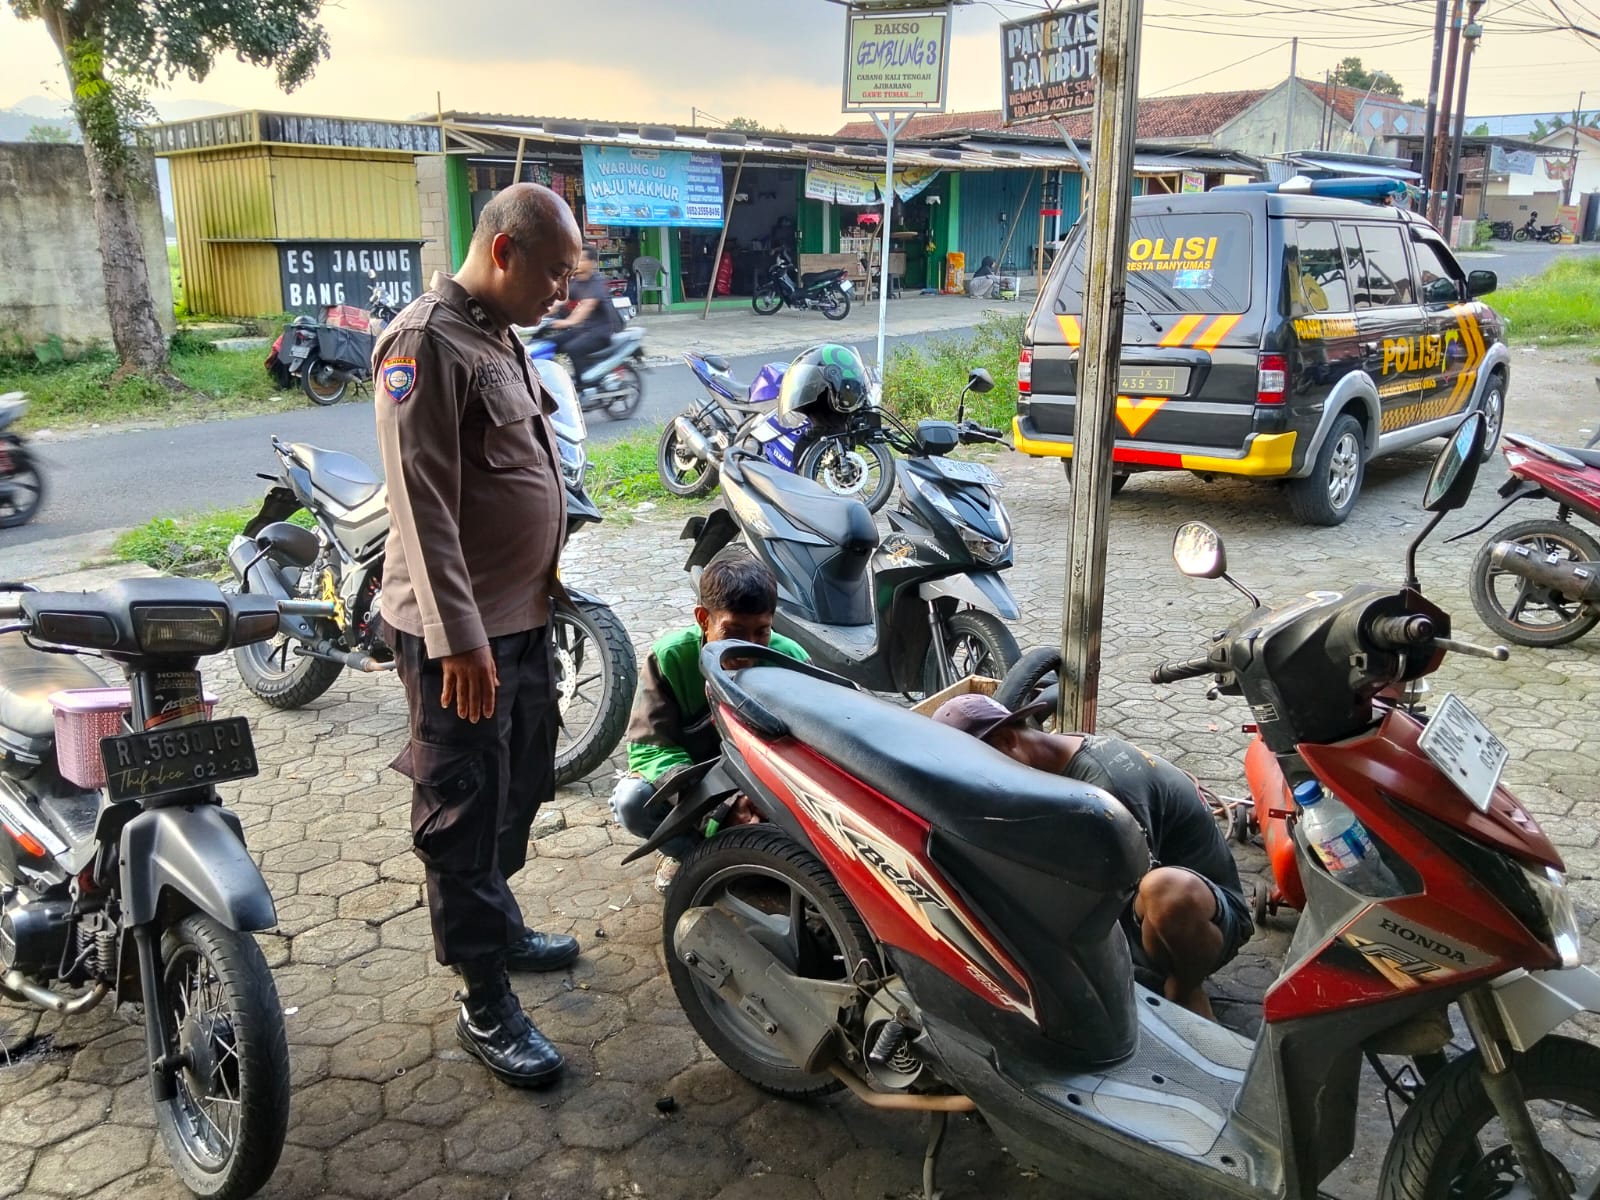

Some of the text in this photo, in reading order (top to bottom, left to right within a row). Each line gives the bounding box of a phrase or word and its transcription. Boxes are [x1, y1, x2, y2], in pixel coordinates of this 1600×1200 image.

[874, 22, 920, 35] BAKSO
[1008, 9, 1098, 58] PANGKAS
[857, 36, 937, 70] GEMBLUNG 3
[1012, 45, 1097, 90] RAMBUT
[1009, 90, 1044, 105] DEWASA
[1074, 80, 1094, 93] SEM
[1075, 93, 1093, 107] 640
[599, 161, 666, 179] WARUNG UD
[591, 179, 625, 199] MAJU
[628, 179, 680, 203] MAKMUR
[287, 249, 411, 273] ES JAGUNG
[1129, 237, 1218, 261] OLISI
[1126, 260, 1211, 271] RESTA BANYUMAS
[290, 283, 346, 306] BANG
[1382, 335, 1442, 375] POLISI
[923, 538, 950, 561] HONDA
[1378, 918, 1468, 965] HONDA
